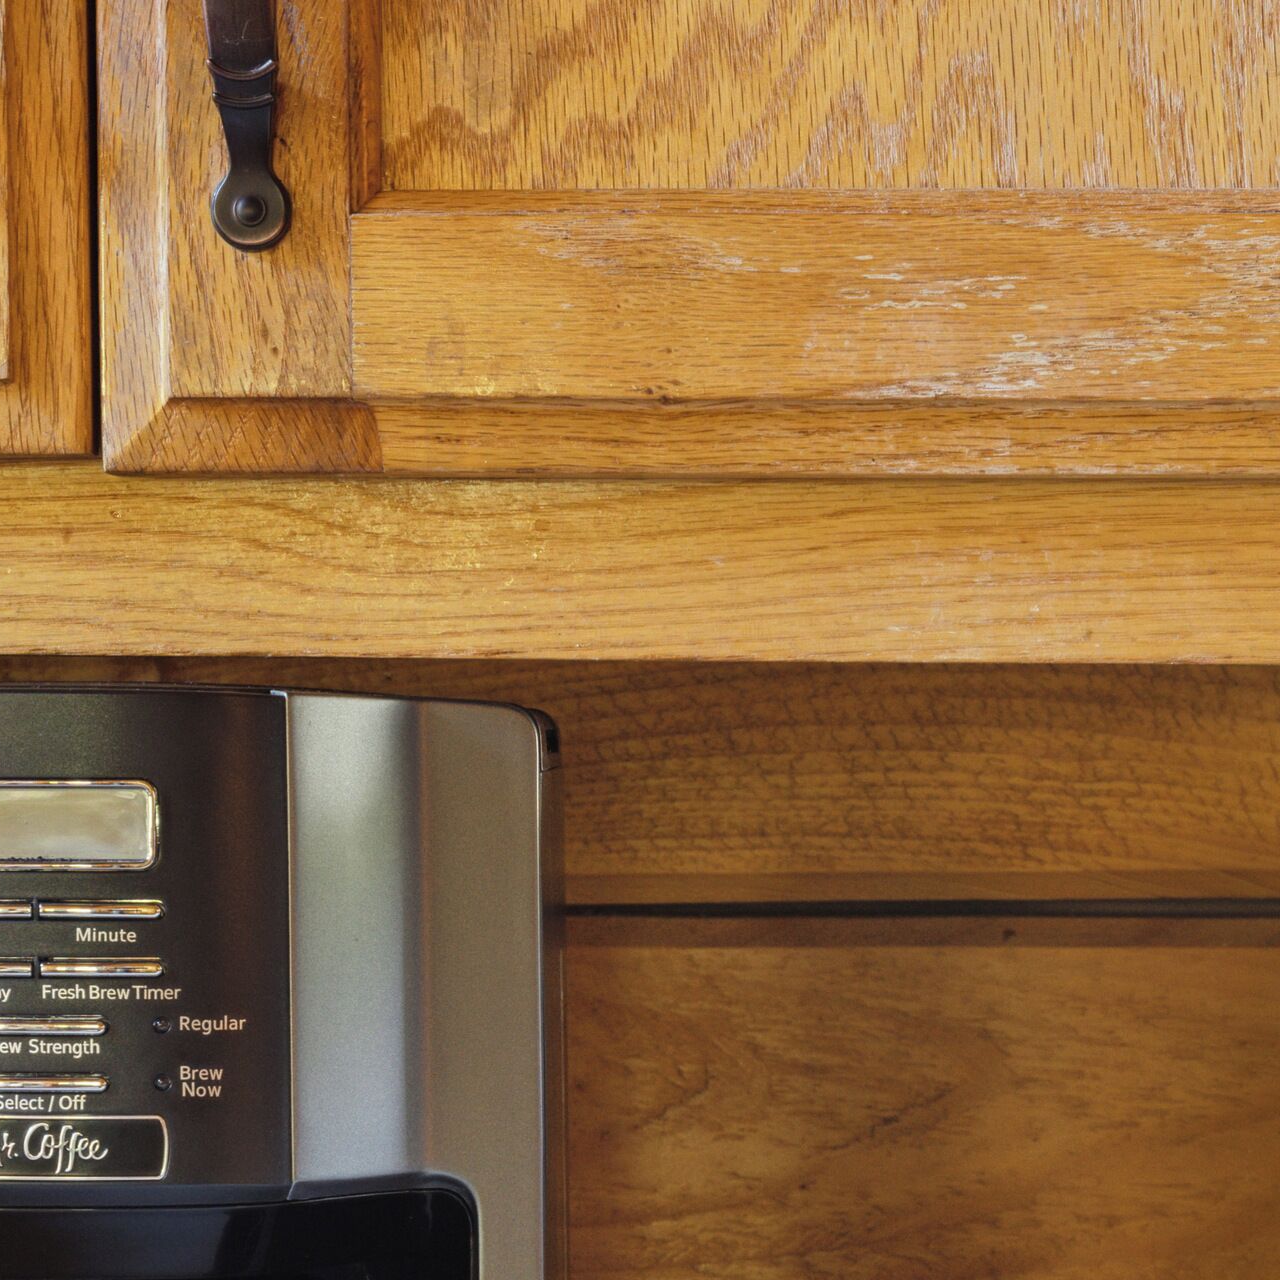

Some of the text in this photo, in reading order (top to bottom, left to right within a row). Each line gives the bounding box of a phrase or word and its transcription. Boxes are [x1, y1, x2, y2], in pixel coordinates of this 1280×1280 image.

[76, 927, 136, 943] Minute
[42, 985, 181, 1000] Fresh Brew Timer
[179, 1016, 246, 1033] Regular
[28, 1039, 100, 1059] Strength
[180, 1066, 223, 1080] Brew
[182, 1082, 221, 1097] Now
[59, 1095, 86, 1110] Off
[24, 1122, 108, 1174] Coffee
